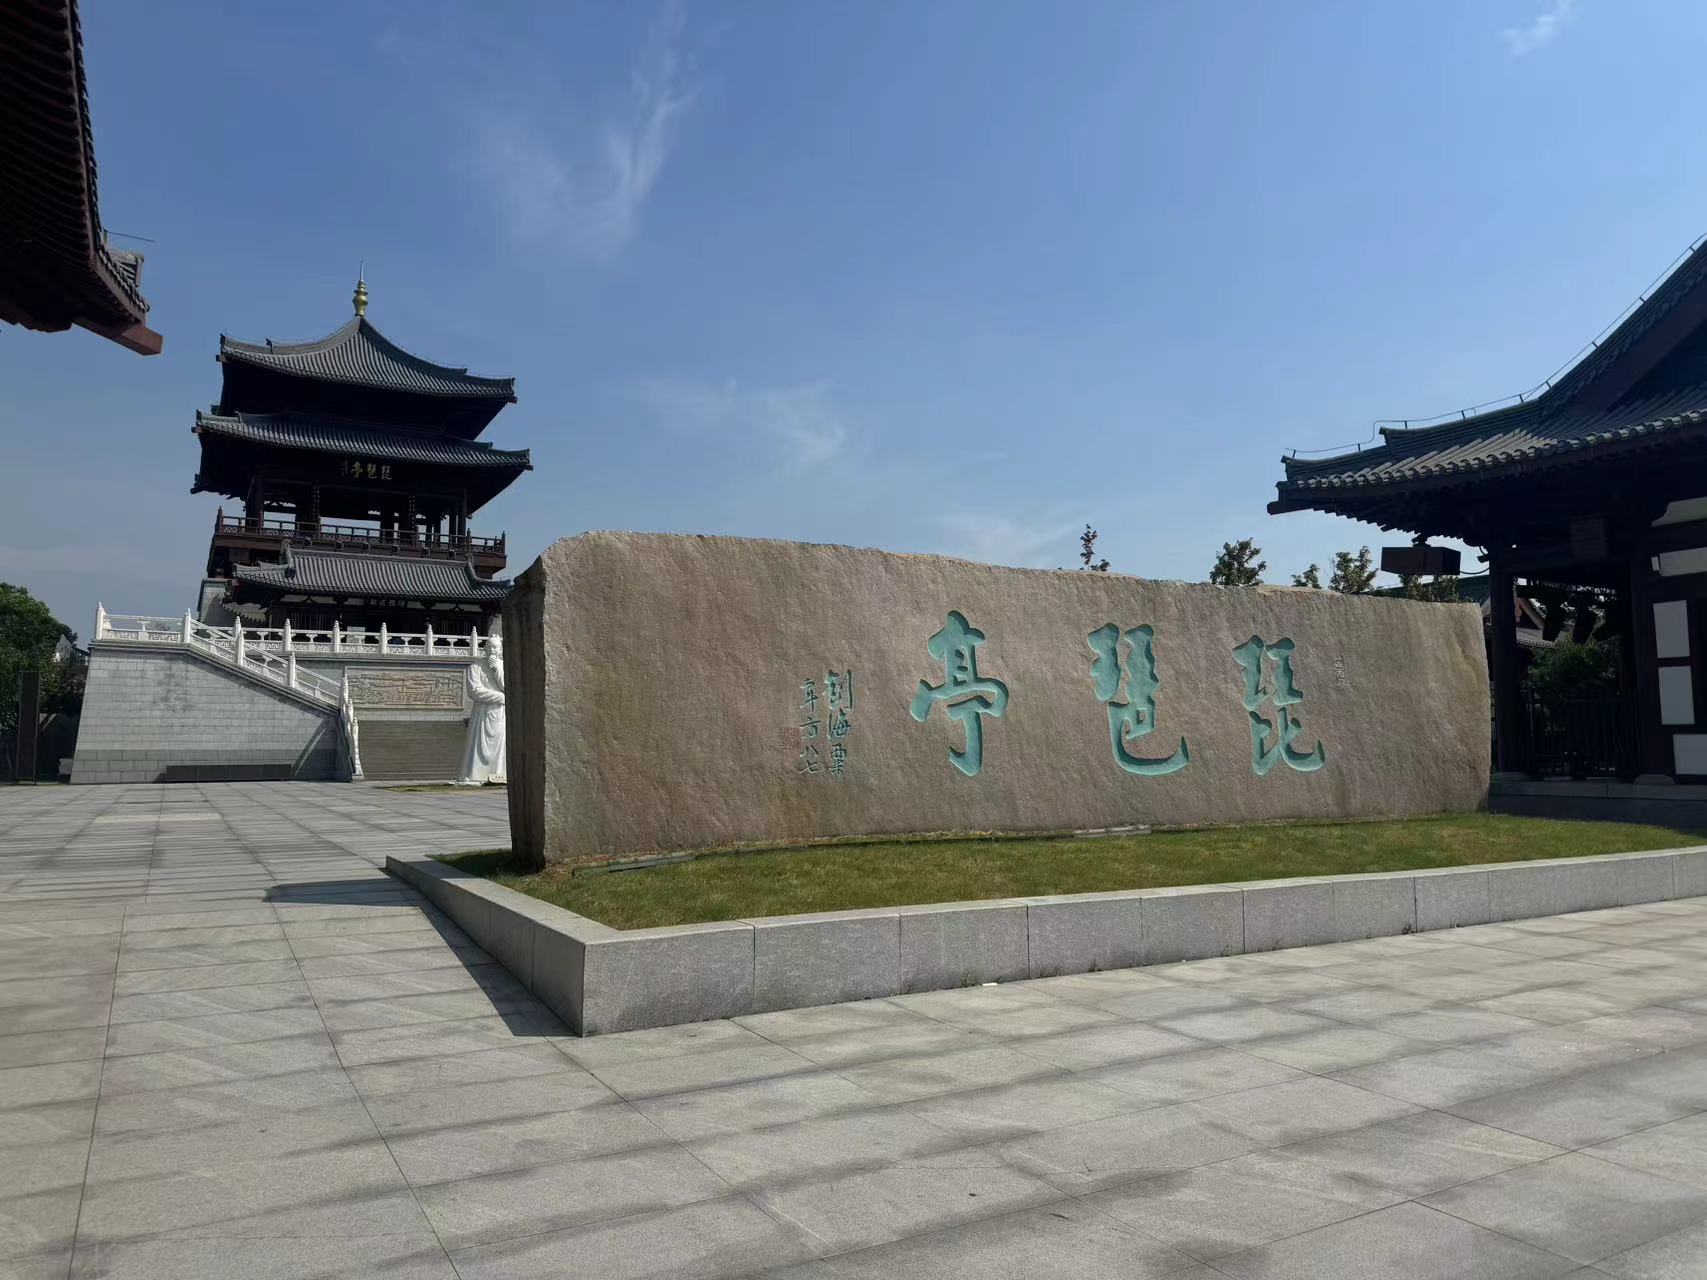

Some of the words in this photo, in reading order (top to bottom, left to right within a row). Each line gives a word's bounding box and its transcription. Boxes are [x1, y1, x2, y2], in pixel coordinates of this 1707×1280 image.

[351, 461, 392, 480] 琵琶亭
[909, 609, 1325, 777] 琵琶亭
